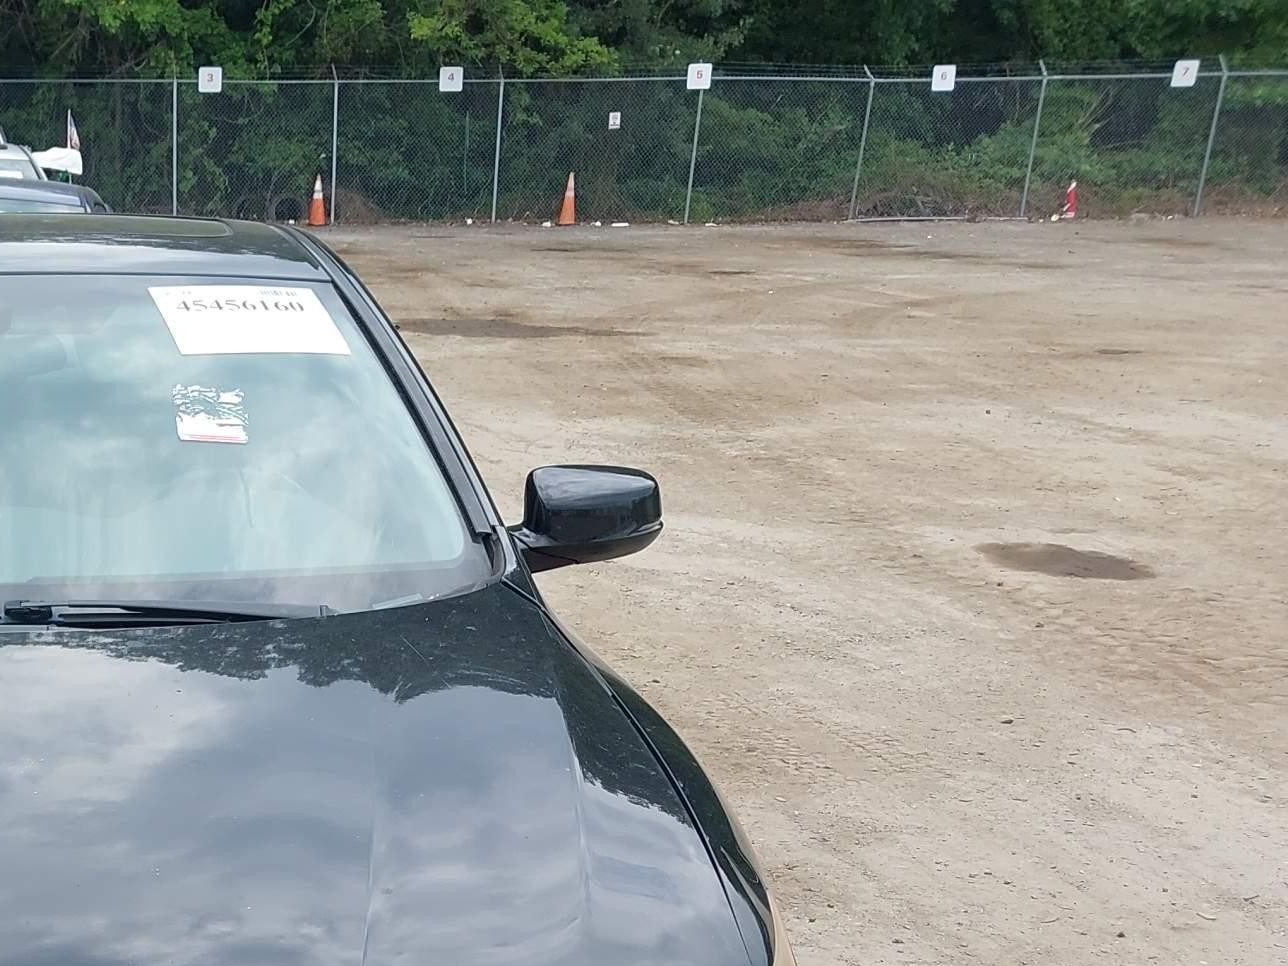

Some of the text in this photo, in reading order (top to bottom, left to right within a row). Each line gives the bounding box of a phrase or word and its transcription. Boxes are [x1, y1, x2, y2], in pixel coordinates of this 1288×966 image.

[696, 70, 703, 79] 5
[941, 72, 947, 80] 6
[1183, 67, 1190, 76] 7
[207, 73, 214, 82] 3
[447, 72, 454, 81] 4
[176, 299, 305, 312] 45456160
